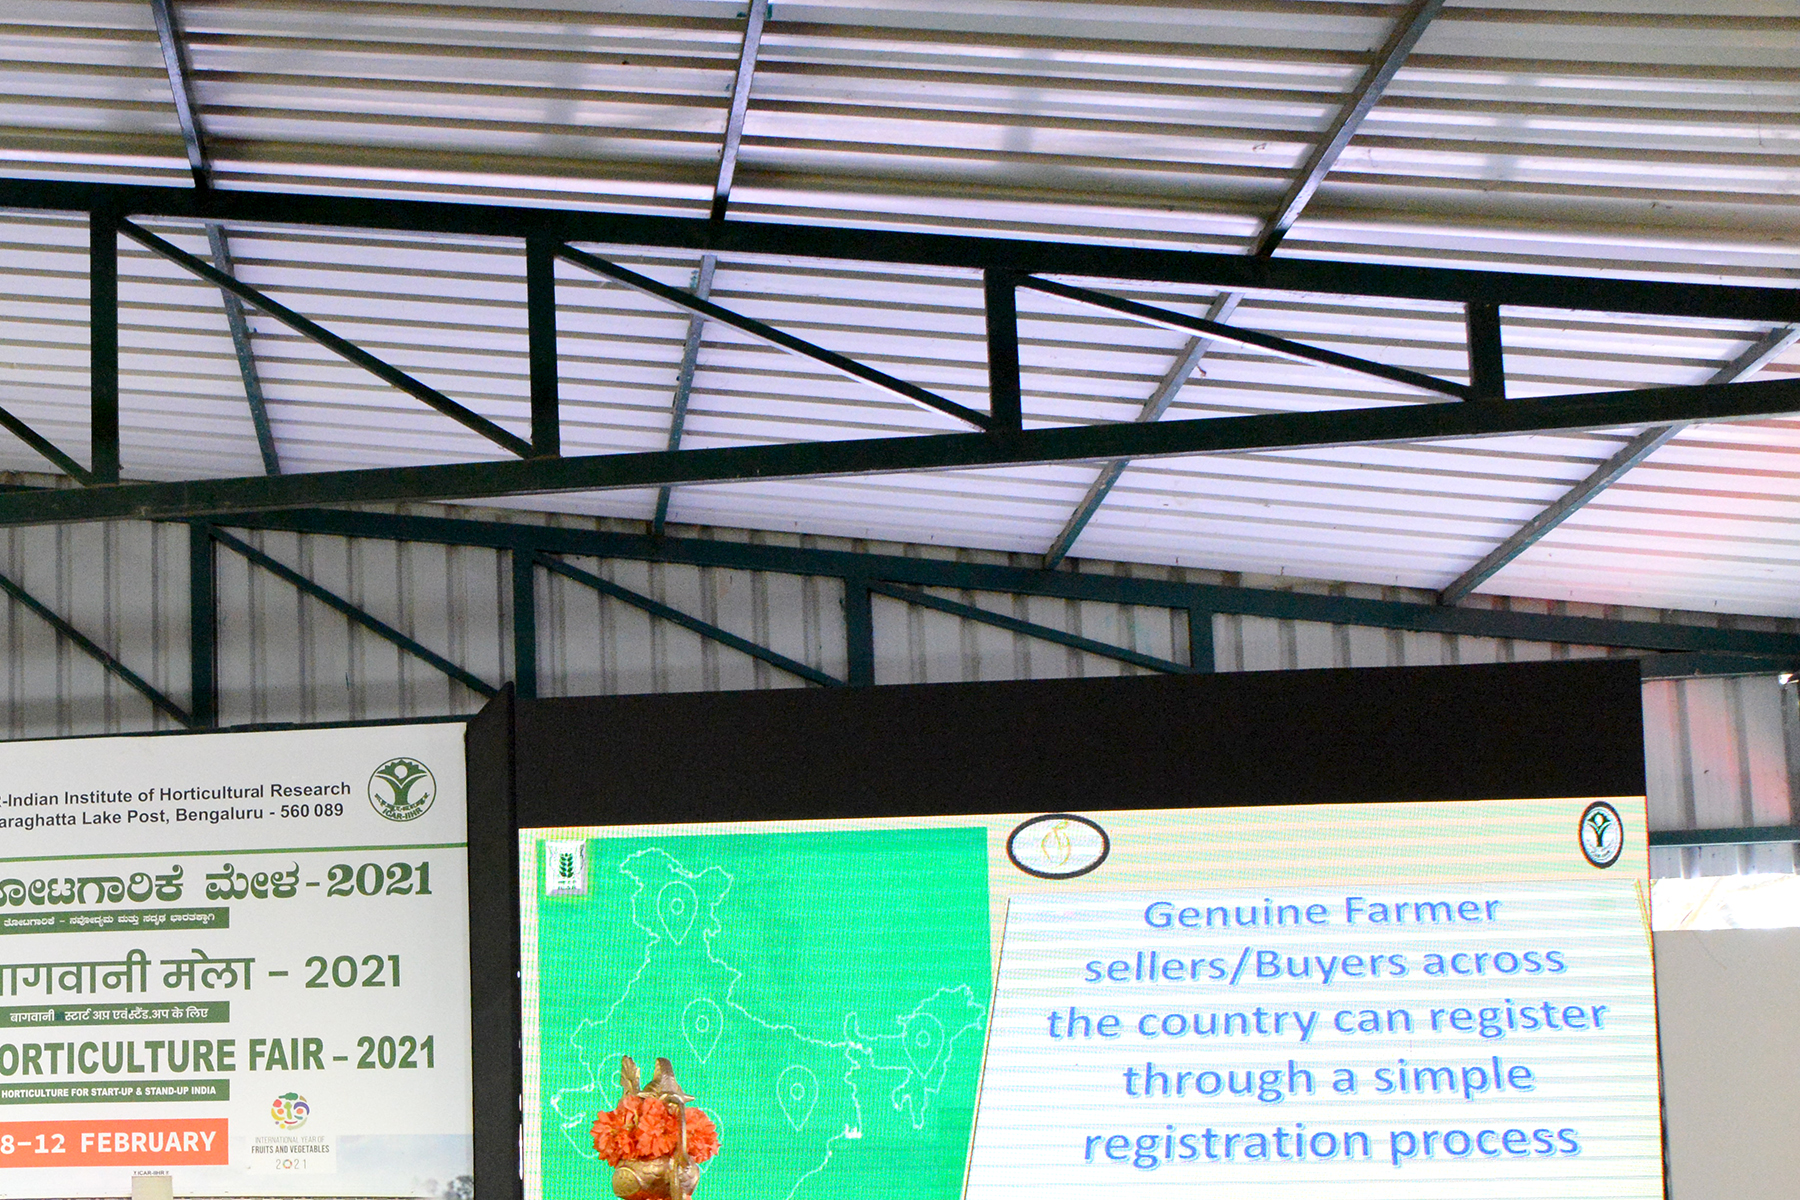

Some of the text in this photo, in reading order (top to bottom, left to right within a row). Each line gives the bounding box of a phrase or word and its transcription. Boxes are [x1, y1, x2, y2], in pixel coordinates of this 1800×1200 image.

[65, 790, 133, 805] Institute
[138, 788, 155, 802] of
[160, 784, 264, 801] Horticultural
[270, 781, 351, 797] Research
[82, 810, 122, 825] Lake
[128, 808, 170, 824] Post,
[176, 806, 264, 824] Bengaluru
[280, 804, 310, 818] 560
[314, 802, 344, 817] 089
[1144, 896, 1503, 929] Genuine Farmer
[160, 948, 255, 991] मेला
[305, 954, 402, 989] 2021
[1084, 946, 1567, 986] sellers/Buyers across
[10, 1009, 56, 1023] बागवानी
[172, 1006, 183, 1019] के
[185, 1005, 209, 1019] लिए
[1047, 998, 1610, 1043] the country can register
[248, 1036, 325, 1072] FAIR
[357, 1035, 436, 1070] 2021
[1123, 1056, 1535, 1103] through a simple
[1, 1085, 217, 1099] HORTICULTURE FOR START-UP & STAND-UP INDIA
[81, 1130, 217, 1153] FEBRUARY
[251, 1144, 330, 1154] FRUITS AND VEGETABLES
[255, 1136, 299, 1144] INTERNATIONAL
[1084, 1122, 1582, 1170] registration process
[275, 1158, 307, 1170] 2021
